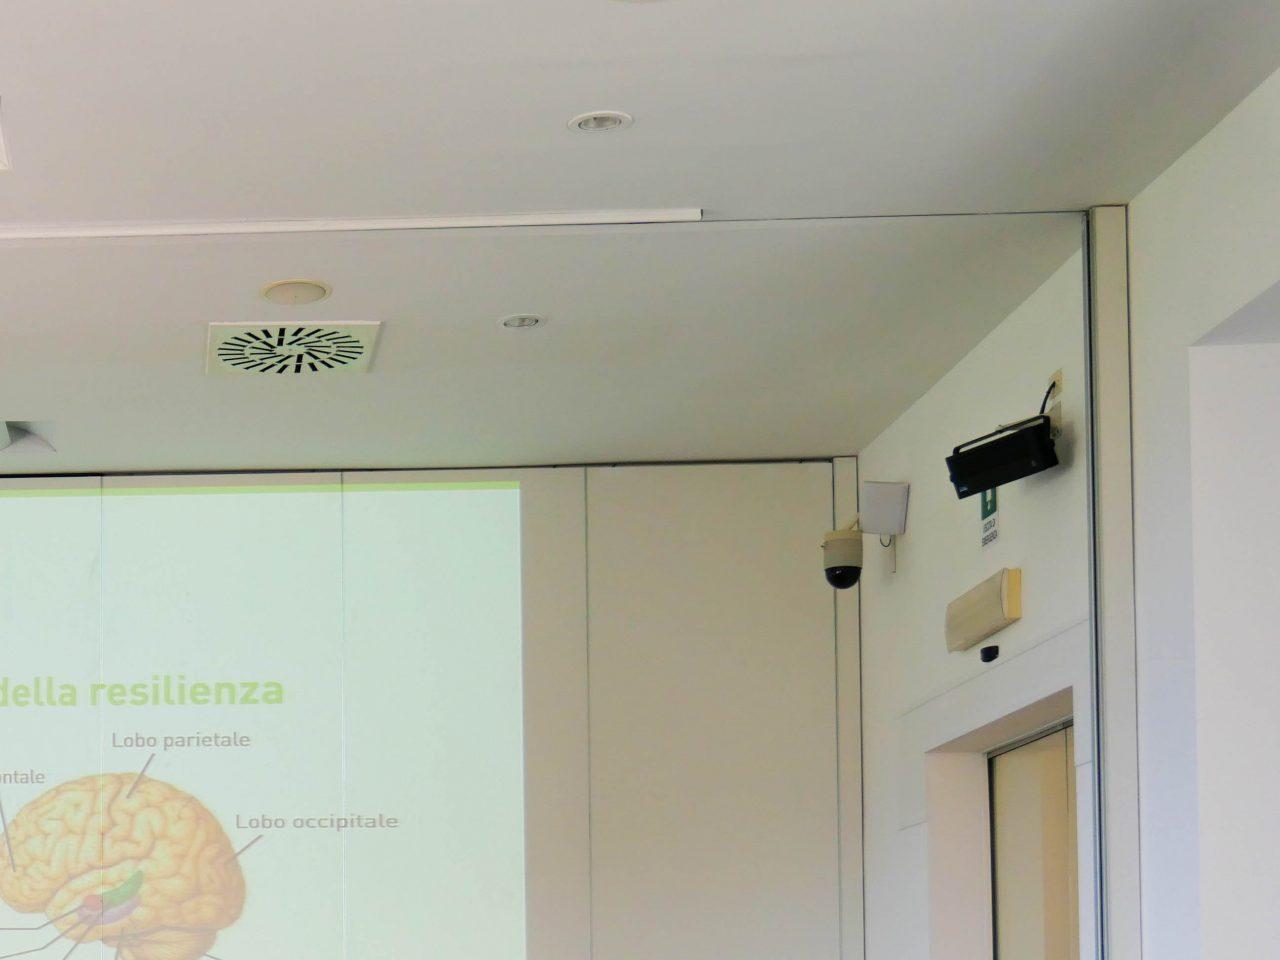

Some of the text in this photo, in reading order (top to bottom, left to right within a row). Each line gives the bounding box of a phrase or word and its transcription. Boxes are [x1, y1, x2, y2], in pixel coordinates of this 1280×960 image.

[90, 674, 286, 706] resilienza
[112, 731, 251, 752] Lobo parietale
[235, 813, 399, 833] Lobo occipitale
